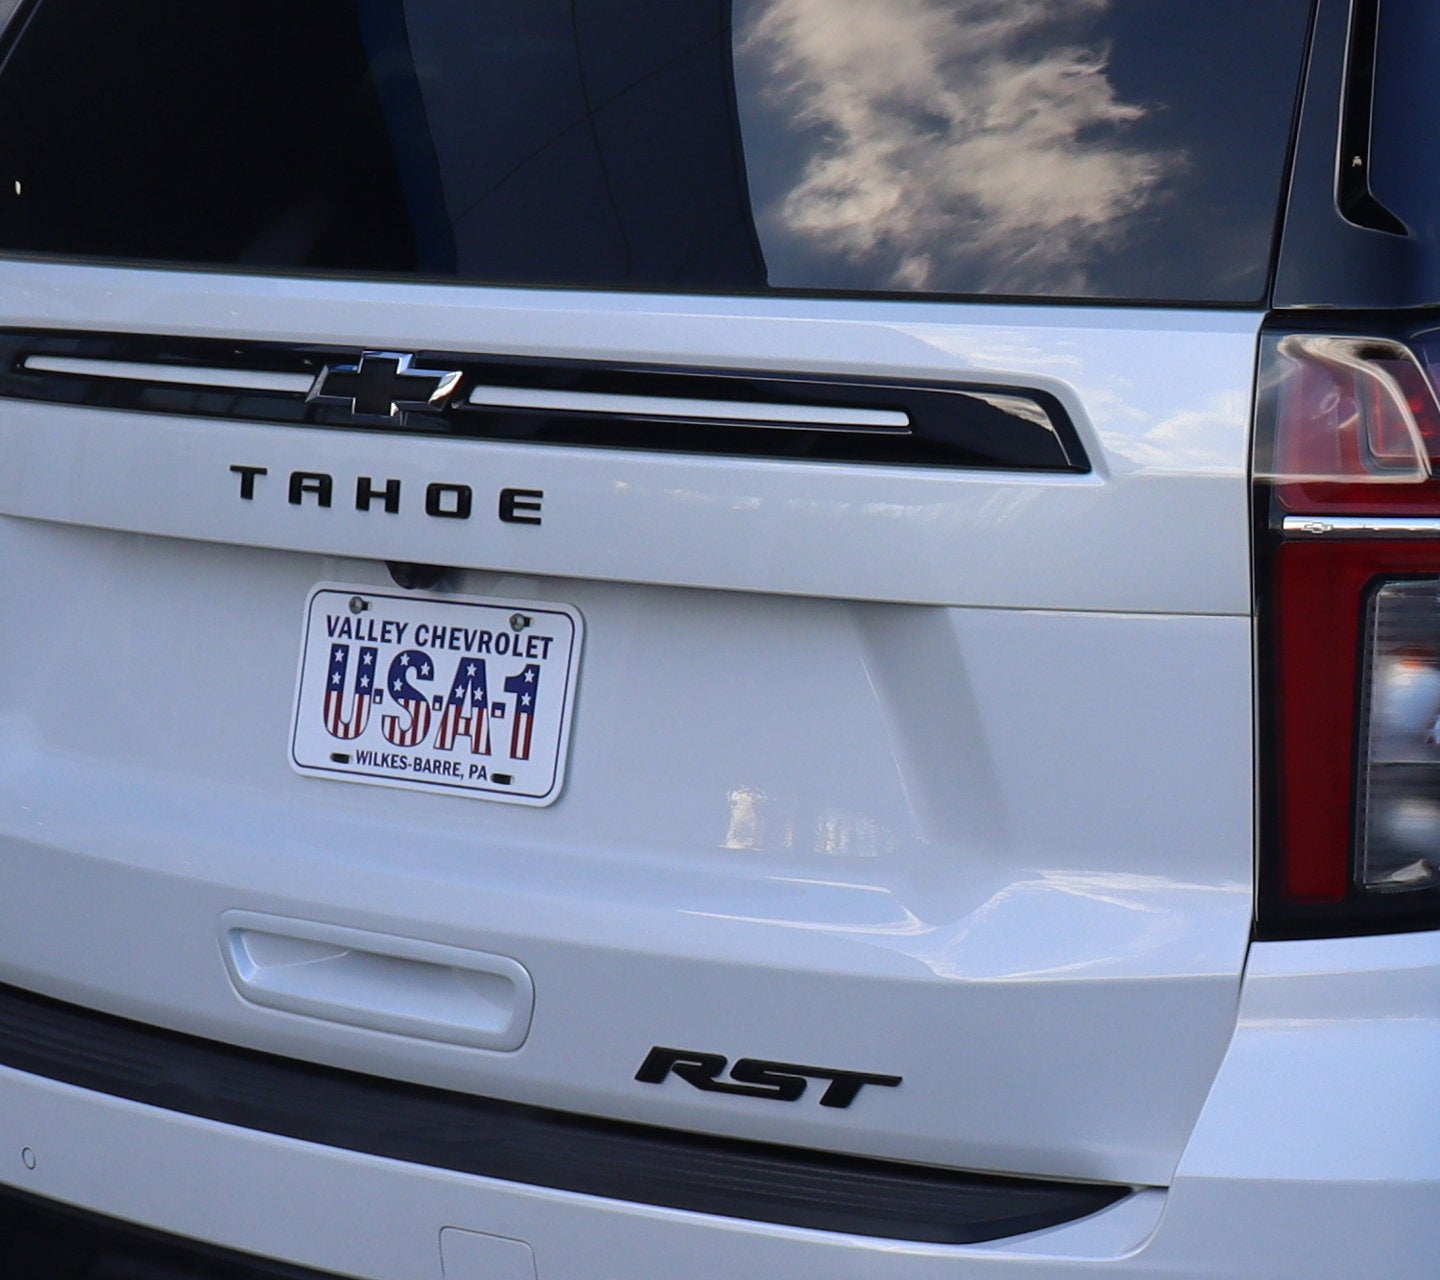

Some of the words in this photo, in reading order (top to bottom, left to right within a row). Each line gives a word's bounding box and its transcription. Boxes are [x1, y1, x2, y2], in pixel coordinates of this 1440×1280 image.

[229, 463, 545, 526] TAHOE
[326, 614, 409, 645] VALLEY
[414, 623, 555, 661] CHEVROLET
[356, 748, 465, 781] WILKES-BARRE,
[468, 763, 489, 782] PA
[633, 1045, 904, 1110] RST
